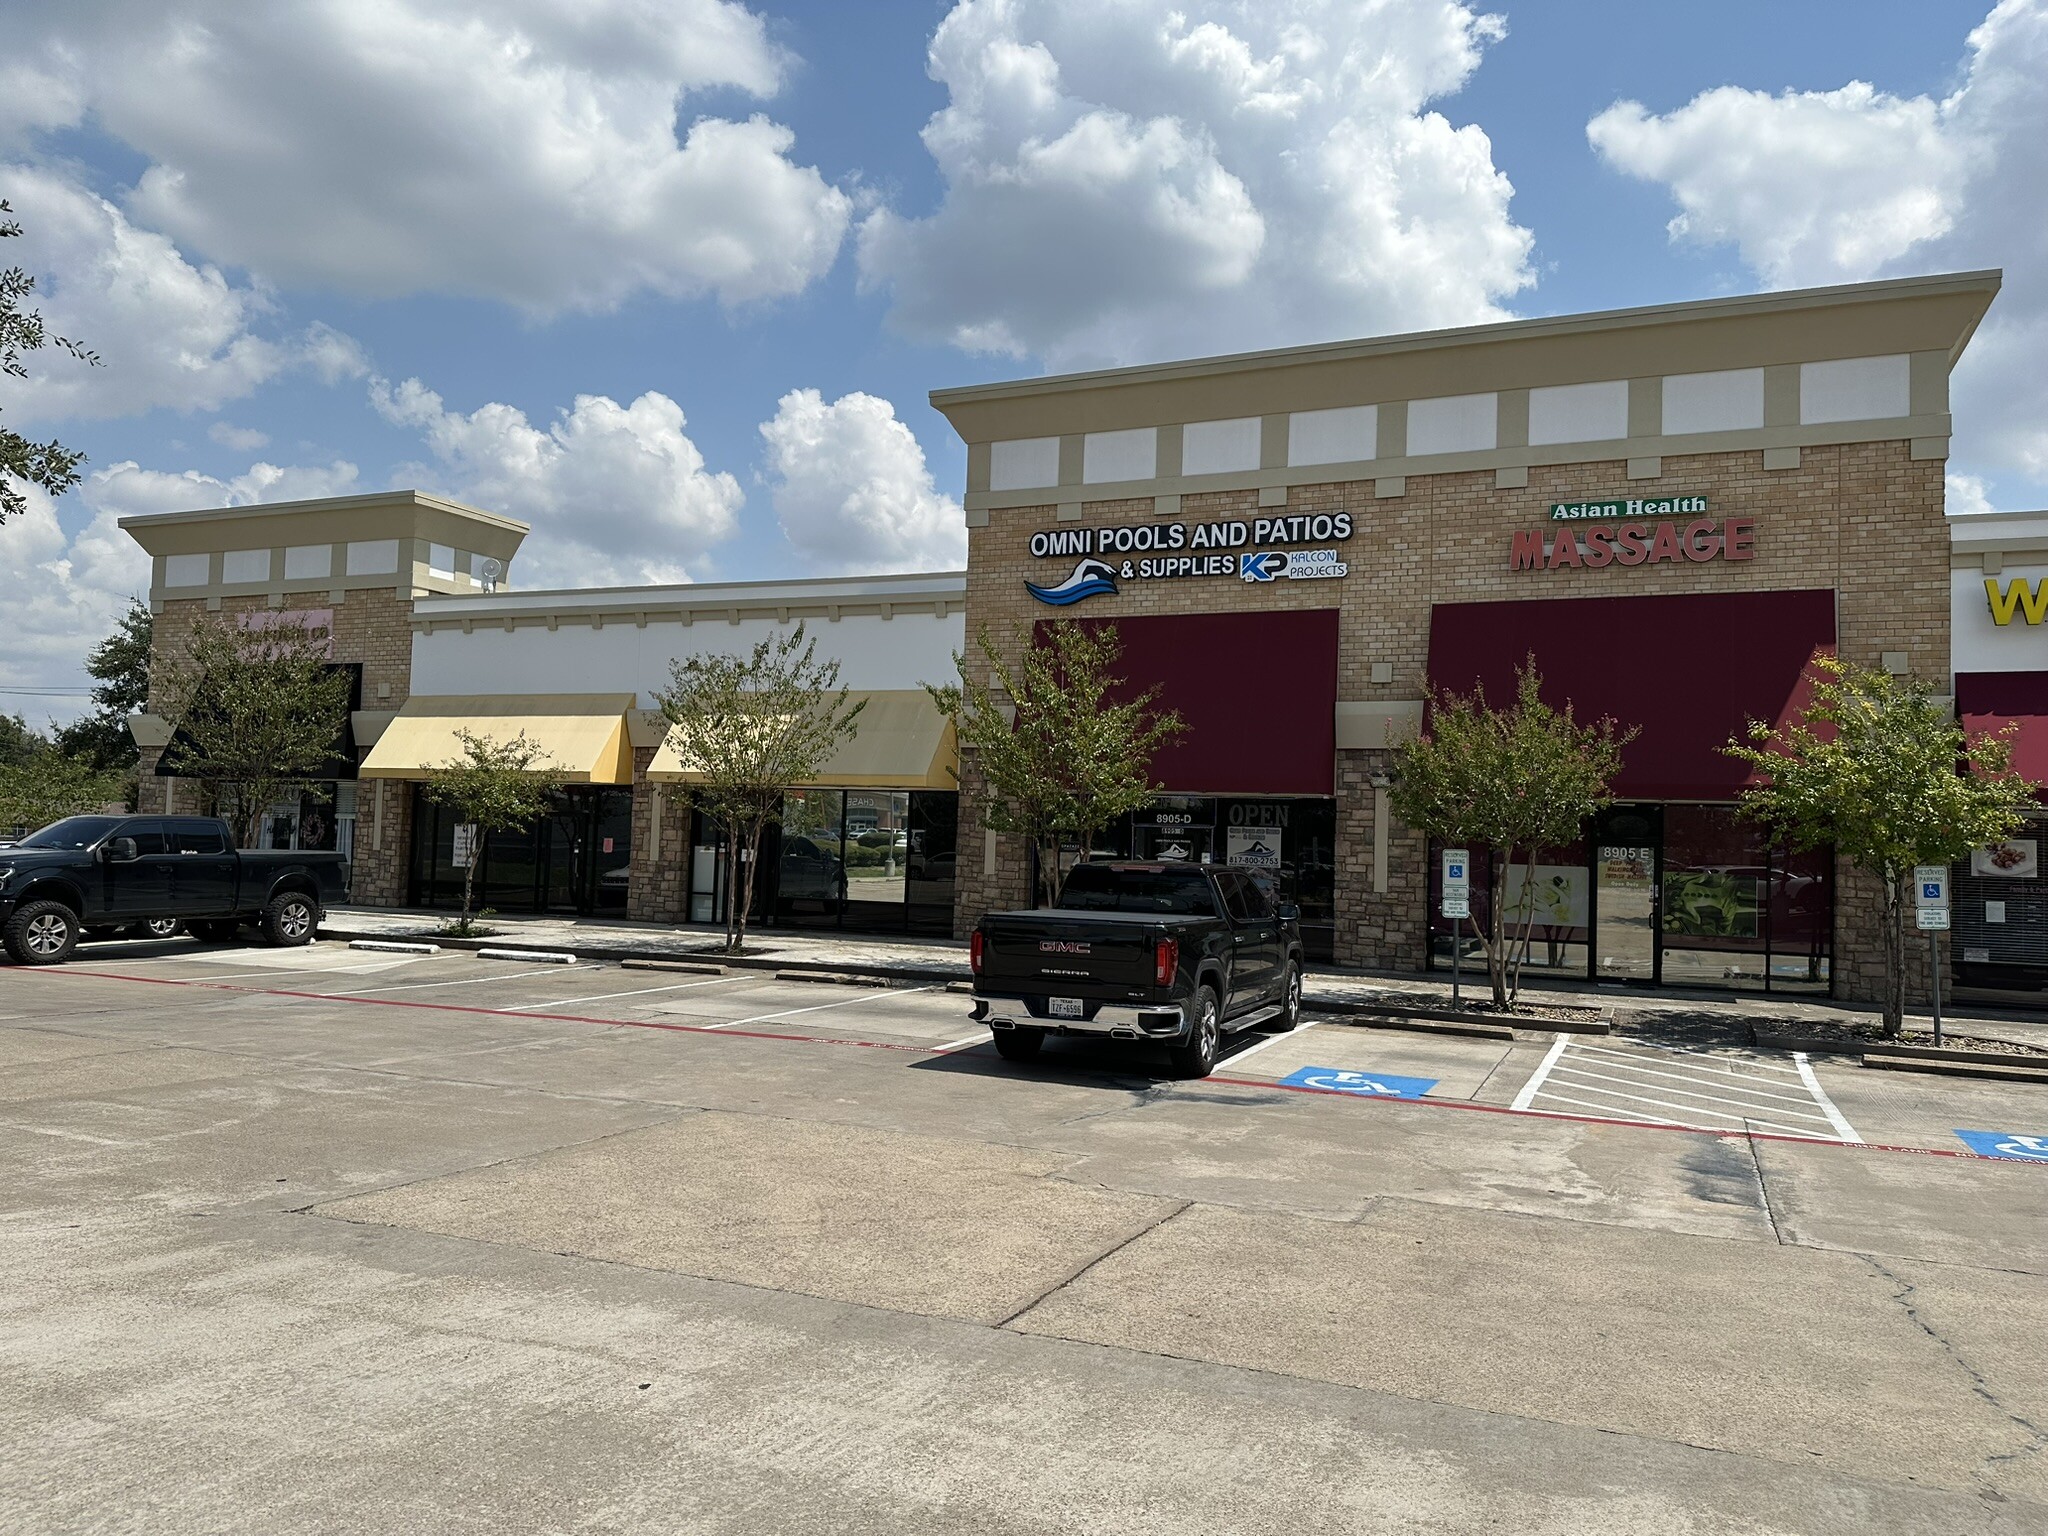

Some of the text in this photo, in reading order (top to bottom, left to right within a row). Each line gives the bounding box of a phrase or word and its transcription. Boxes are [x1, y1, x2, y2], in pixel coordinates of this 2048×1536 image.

[1552, 497, 1706, 519] Asian Health
[1031, 513, 1351, 556] OMNI POOLS AND PATIOS
[1510, 518, 1754, 570] MASSAGE
[1291, 551, 1335, 563] KALCON
[1121, 555, 1235, 578] & SUPPLIES
[1291, 565, 1345, 577] PROJECTS
[1984, 578, 2048, 626] W
[1156, 814, 1192, 824] 8905-D
[1229, 804, 1290, 827] OPEN
[1604, 847, 1649, 858] 8905 E
[1229, 856, 1279, 865] 817-800-2753
[1040, 941, 1090, 953] GMC
[1887, 1146, 1932, 1155] LANE
